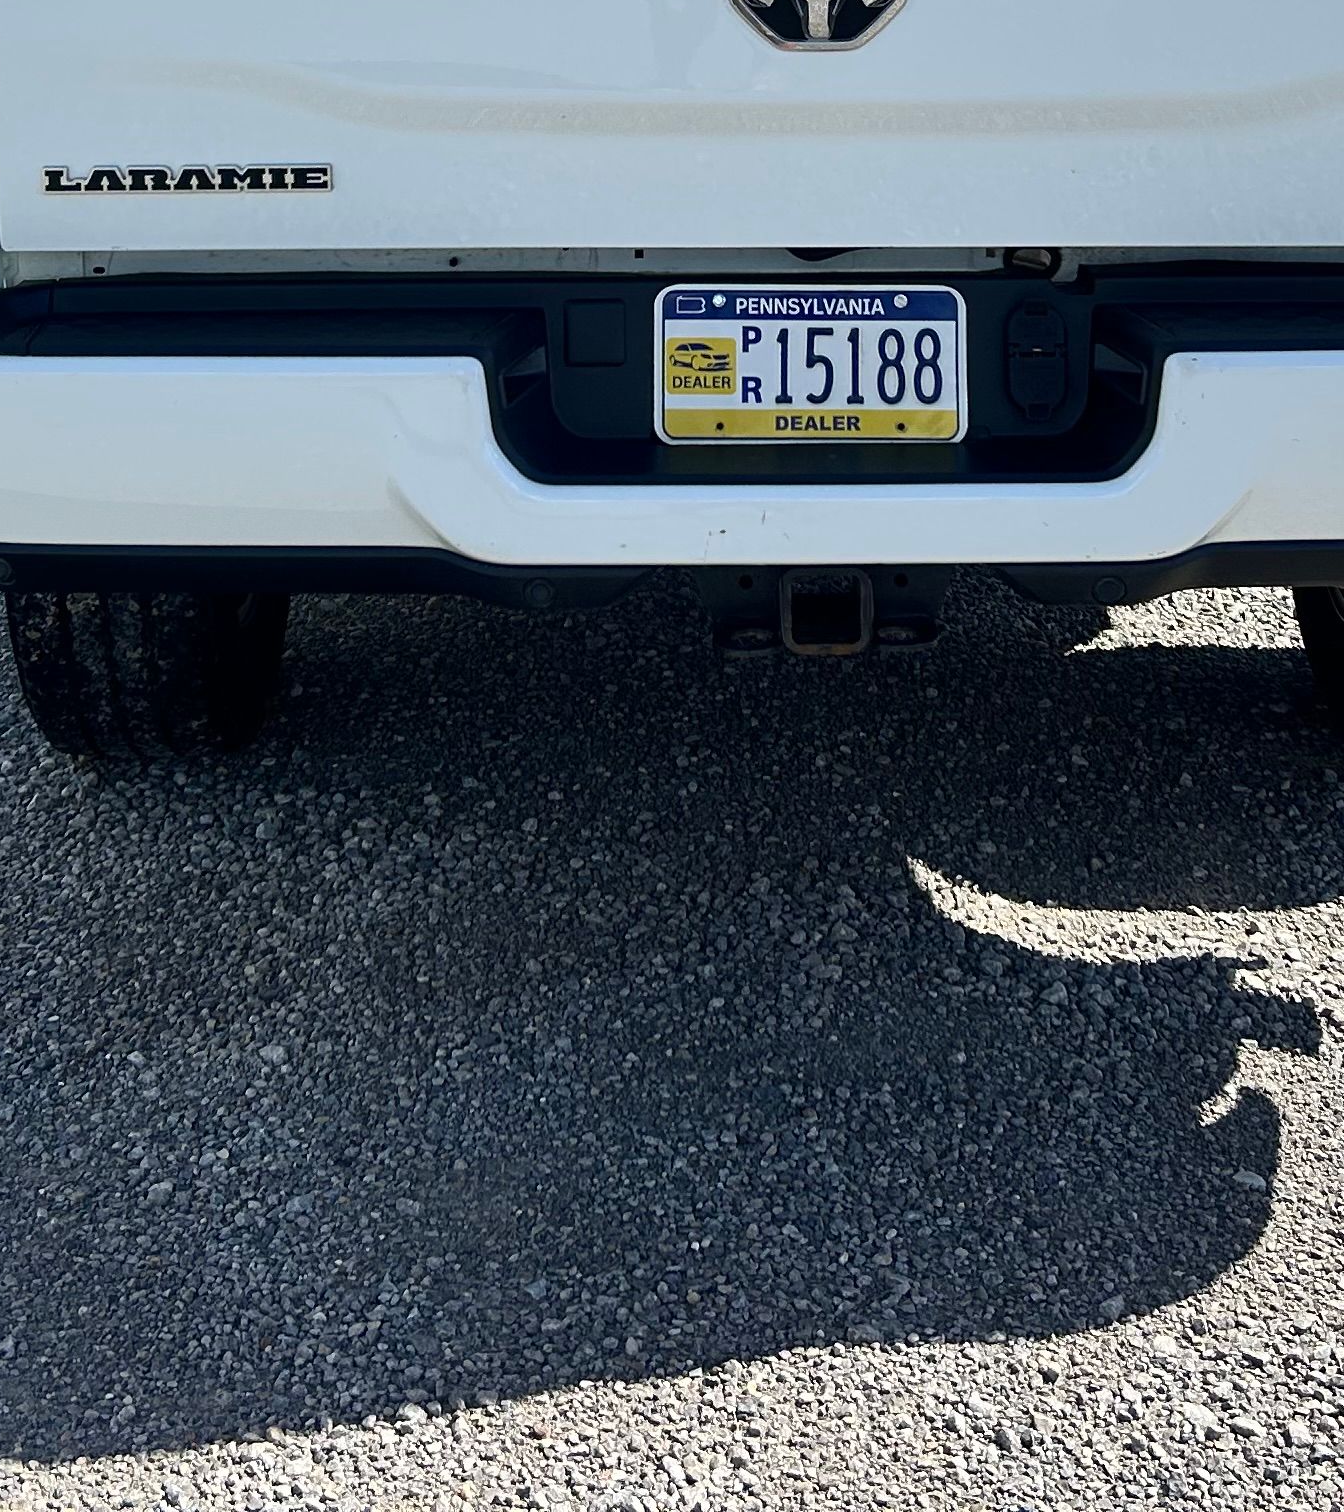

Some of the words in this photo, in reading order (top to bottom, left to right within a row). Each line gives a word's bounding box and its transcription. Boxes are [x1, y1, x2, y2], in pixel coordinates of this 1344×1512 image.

[43, 164, 333, 193] LARAMIE
[736, 297, 885, 316] PENNSYLVANIA
[775, 327, 942, 405] 15188
[672, 375, 732, 389] DEALER
[775, 415, 861, 432] DEALER
